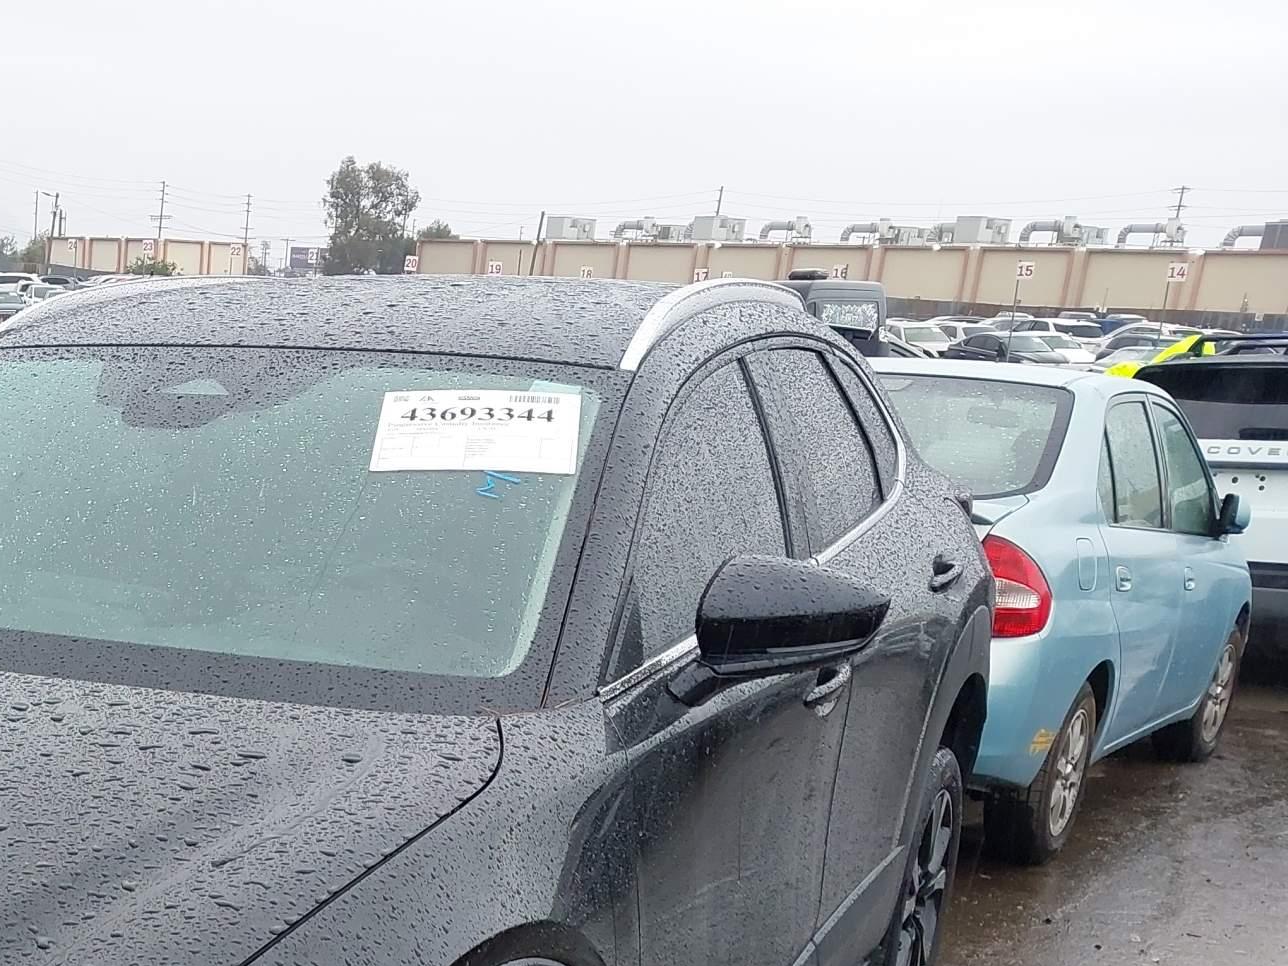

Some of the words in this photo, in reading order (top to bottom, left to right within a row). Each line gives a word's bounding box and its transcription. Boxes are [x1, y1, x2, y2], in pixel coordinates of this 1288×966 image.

[143, 242, 153, 251] 23
[231, 246, 241, 256] 22
[405, 258, 417, 269] 20
[489, 264, 502, 275] 19
[581, 268, 592, 278] 18
[833, 267, 847, 279] 16
[1017, 265, 1033, 277] 15
[1168, 266, 1186, 279] 14
[695, 271, 708, 282] 17
[400, 406, 555, 423] 43693344
[1207, 446, 1288, 456] COVE
